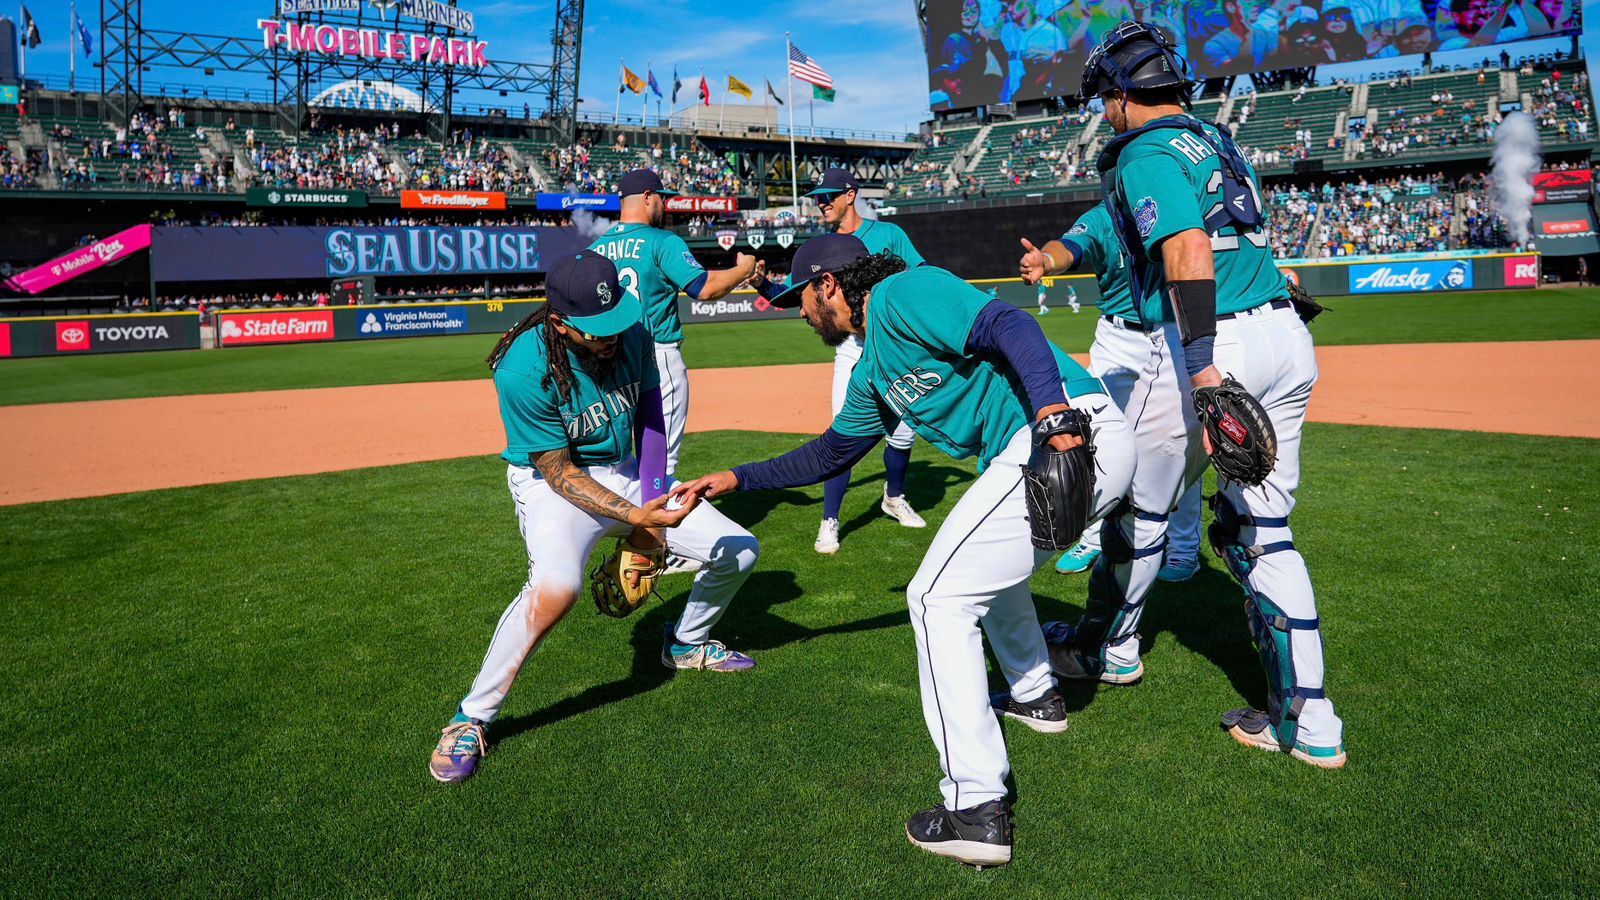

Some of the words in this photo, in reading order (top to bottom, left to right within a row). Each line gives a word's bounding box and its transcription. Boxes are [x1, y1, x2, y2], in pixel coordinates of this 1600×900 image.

[400, 0, 474, 33] MARINERS
[258, 19, 407, 60] T-MOBILE
[411, 34, 489, 68] PARK
[284, 193, 348, 203] STARBUCKS
[721, 236, 732, 245] 42
[752, 236, 761, 244] 24
[782, 235, 789, 243] 11
[592, 238, 646, 261] RANCE
[61, 253, 96, 272] Mobile
[1355, 267, 1431, 289] Alaska
[487, 302, 504, 313] 376
[691, 300, 753, 316] KeyBank
[384, 312, 417, 322] Virginia
[418, 311, 447, 320] Mason
[385, 321, 431, 331] Franciscan
[432, 319, 462, 329] Health
[95, 326, 169, 341] TOYOTA
[653, 478, 661, 490] 3
